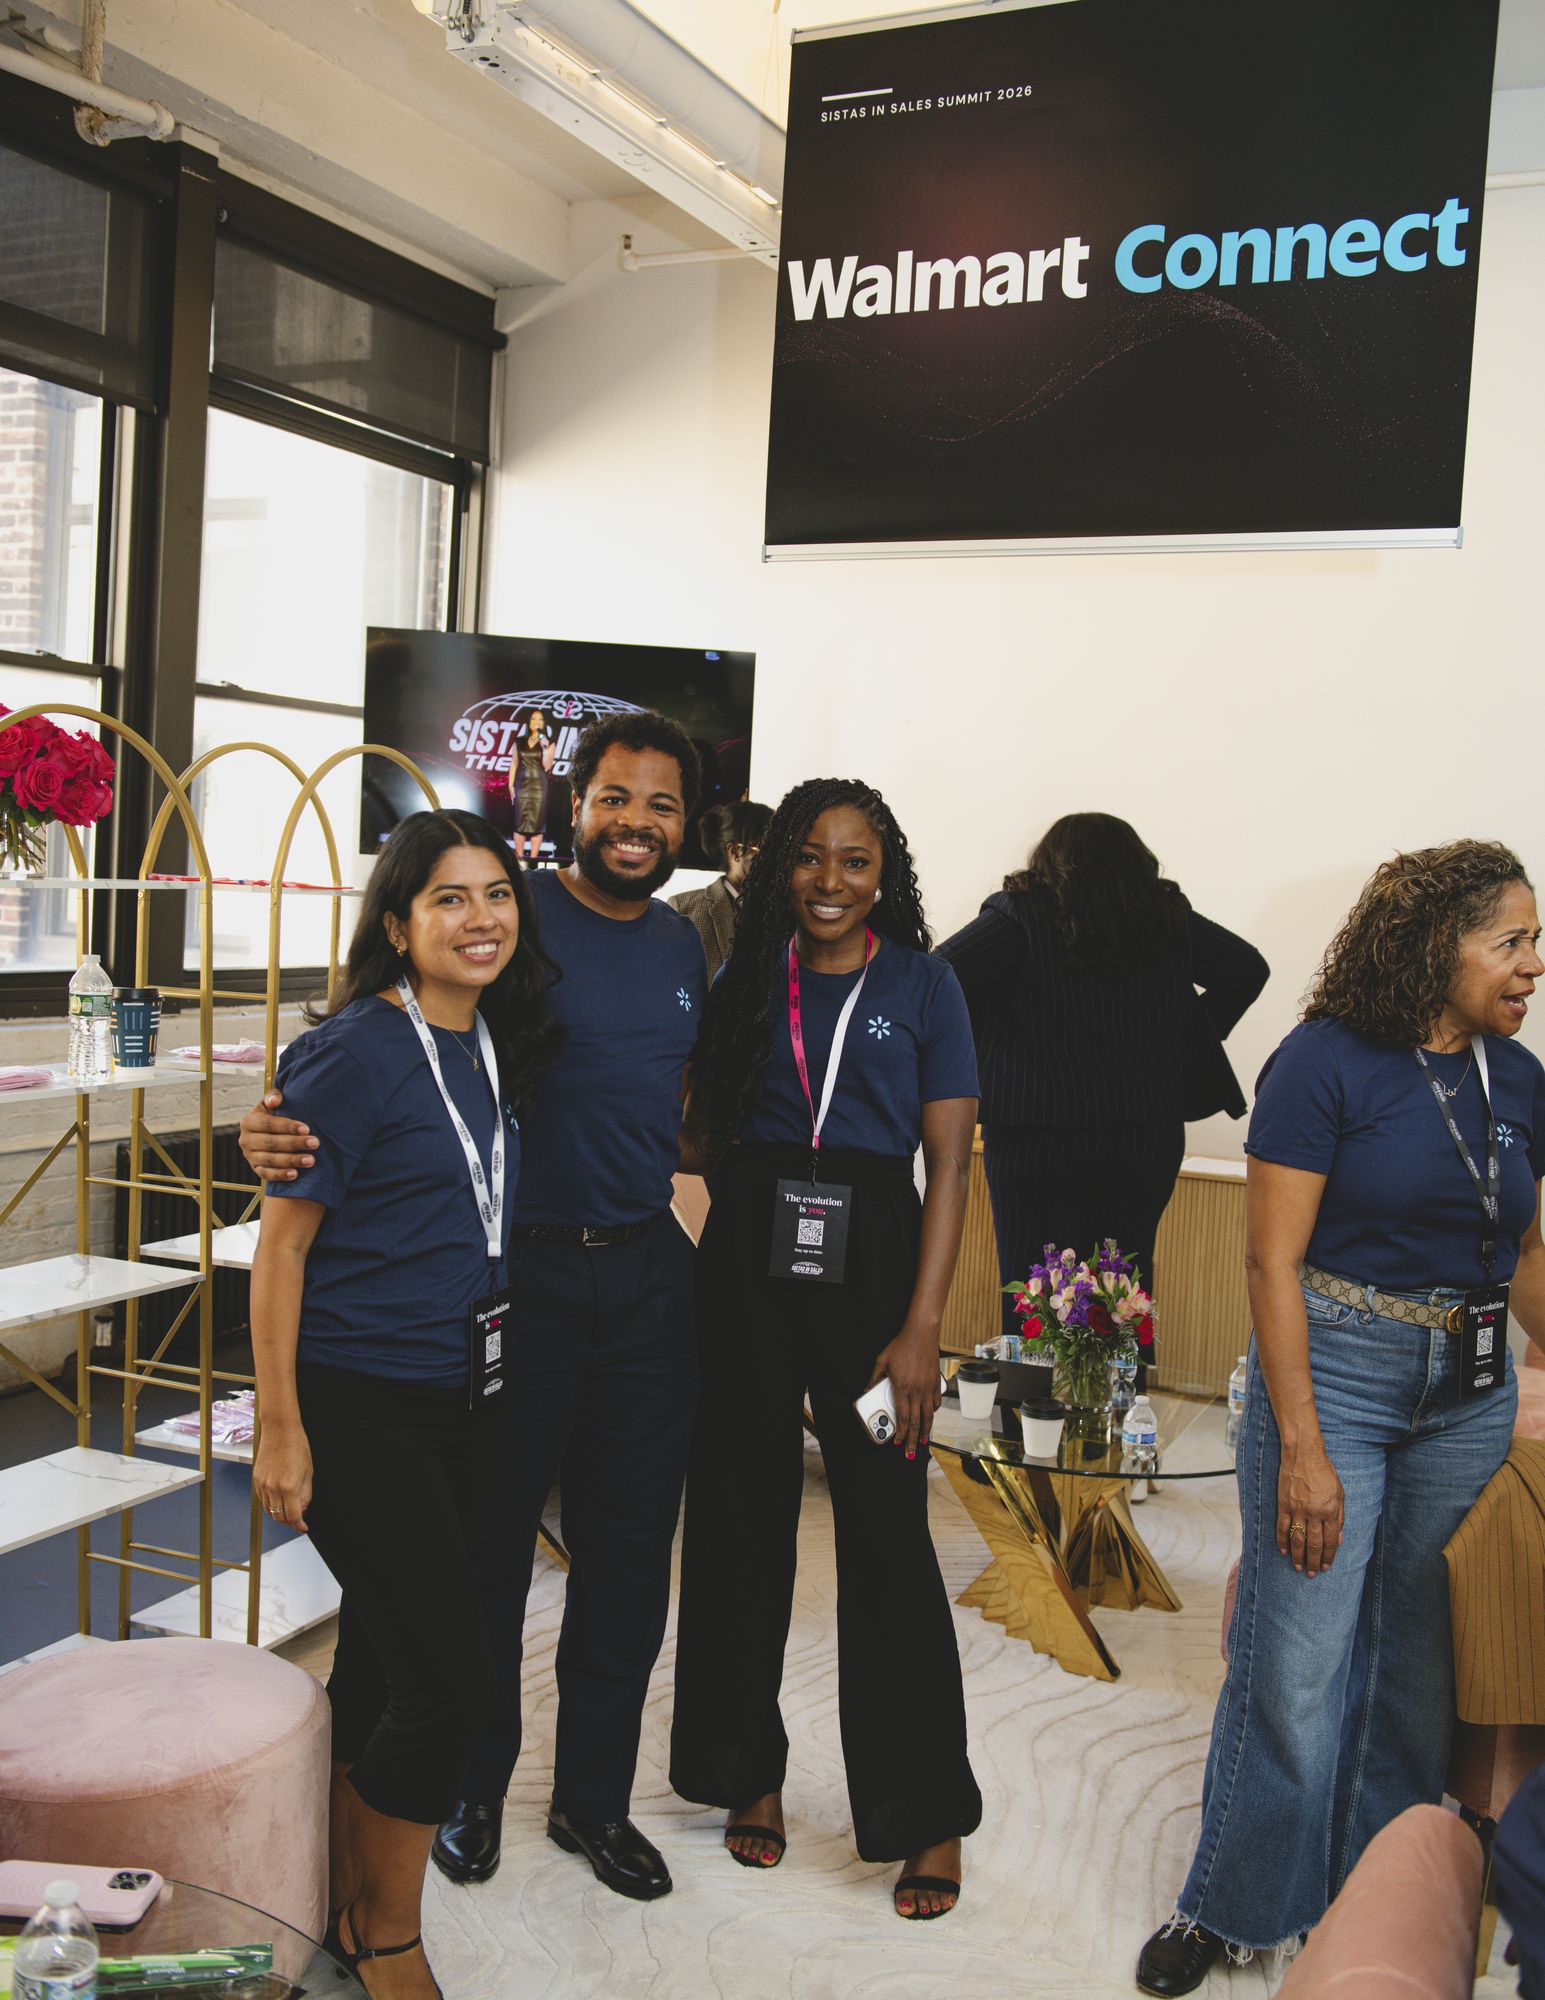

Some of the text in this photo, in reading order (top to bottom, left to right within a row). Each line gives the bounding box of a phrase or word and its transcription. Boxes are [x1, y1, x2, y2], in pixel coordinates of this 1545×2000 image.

[820, 85, 1032, 122] SISTAS IN SALES SUMMIT 2026
[787, 197, 1469, 322] Walmart Connect
[449, 718, 553, 755] SIST
[465, 754, 513, 772] THE
[784, 1193, 843, 1207] The evolution
[799, 1205, 807, 1213] is
[1469, 1305, 1480, 1315] The
